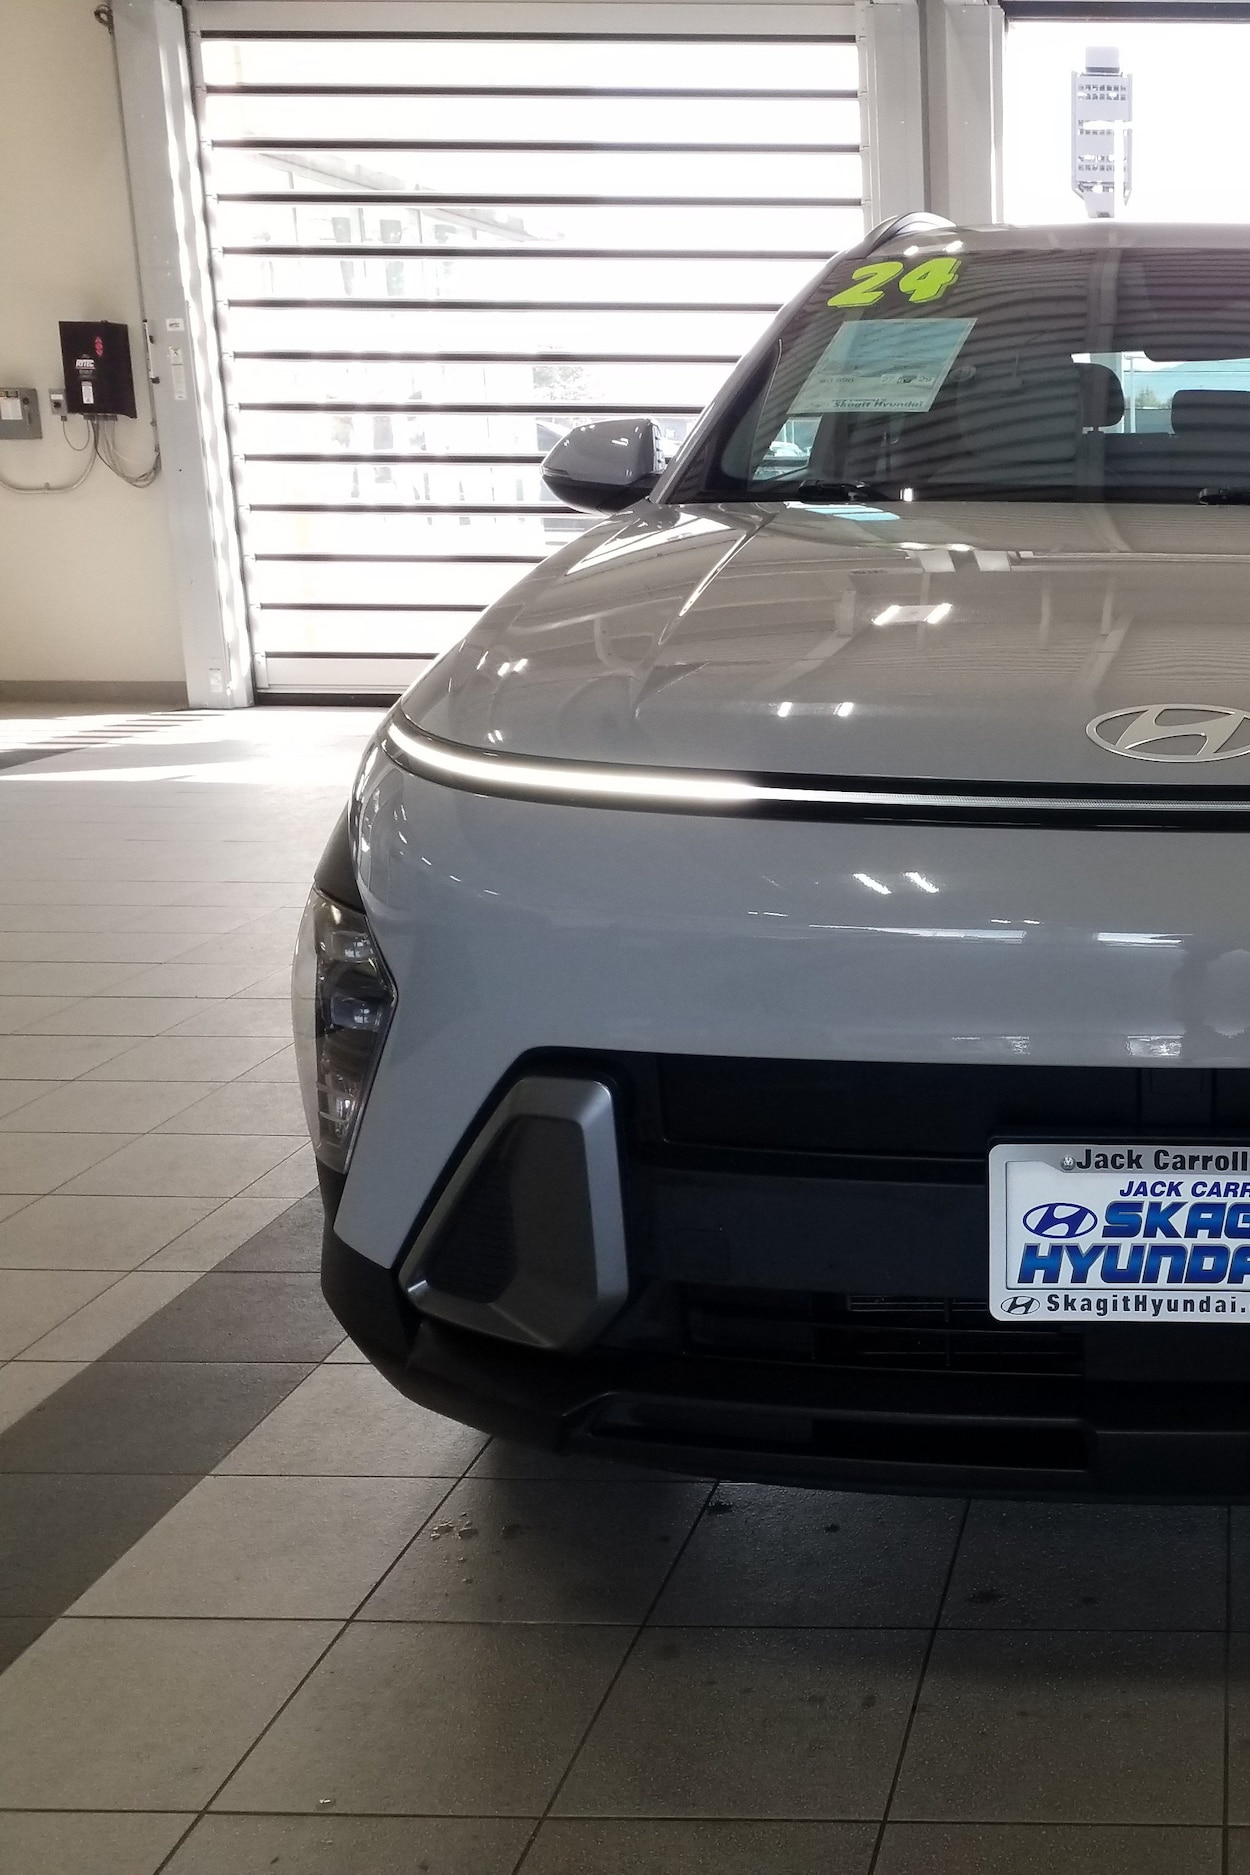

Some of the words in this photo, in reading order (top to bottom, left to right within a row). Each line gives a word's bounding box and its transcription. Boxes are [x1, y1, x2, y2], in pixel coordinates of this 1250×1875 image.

[827, 257, 962, 308] 24
[1076, 1149, 1143, 1170] Jack
[1119, 1181, 1184, 1198] JACK
